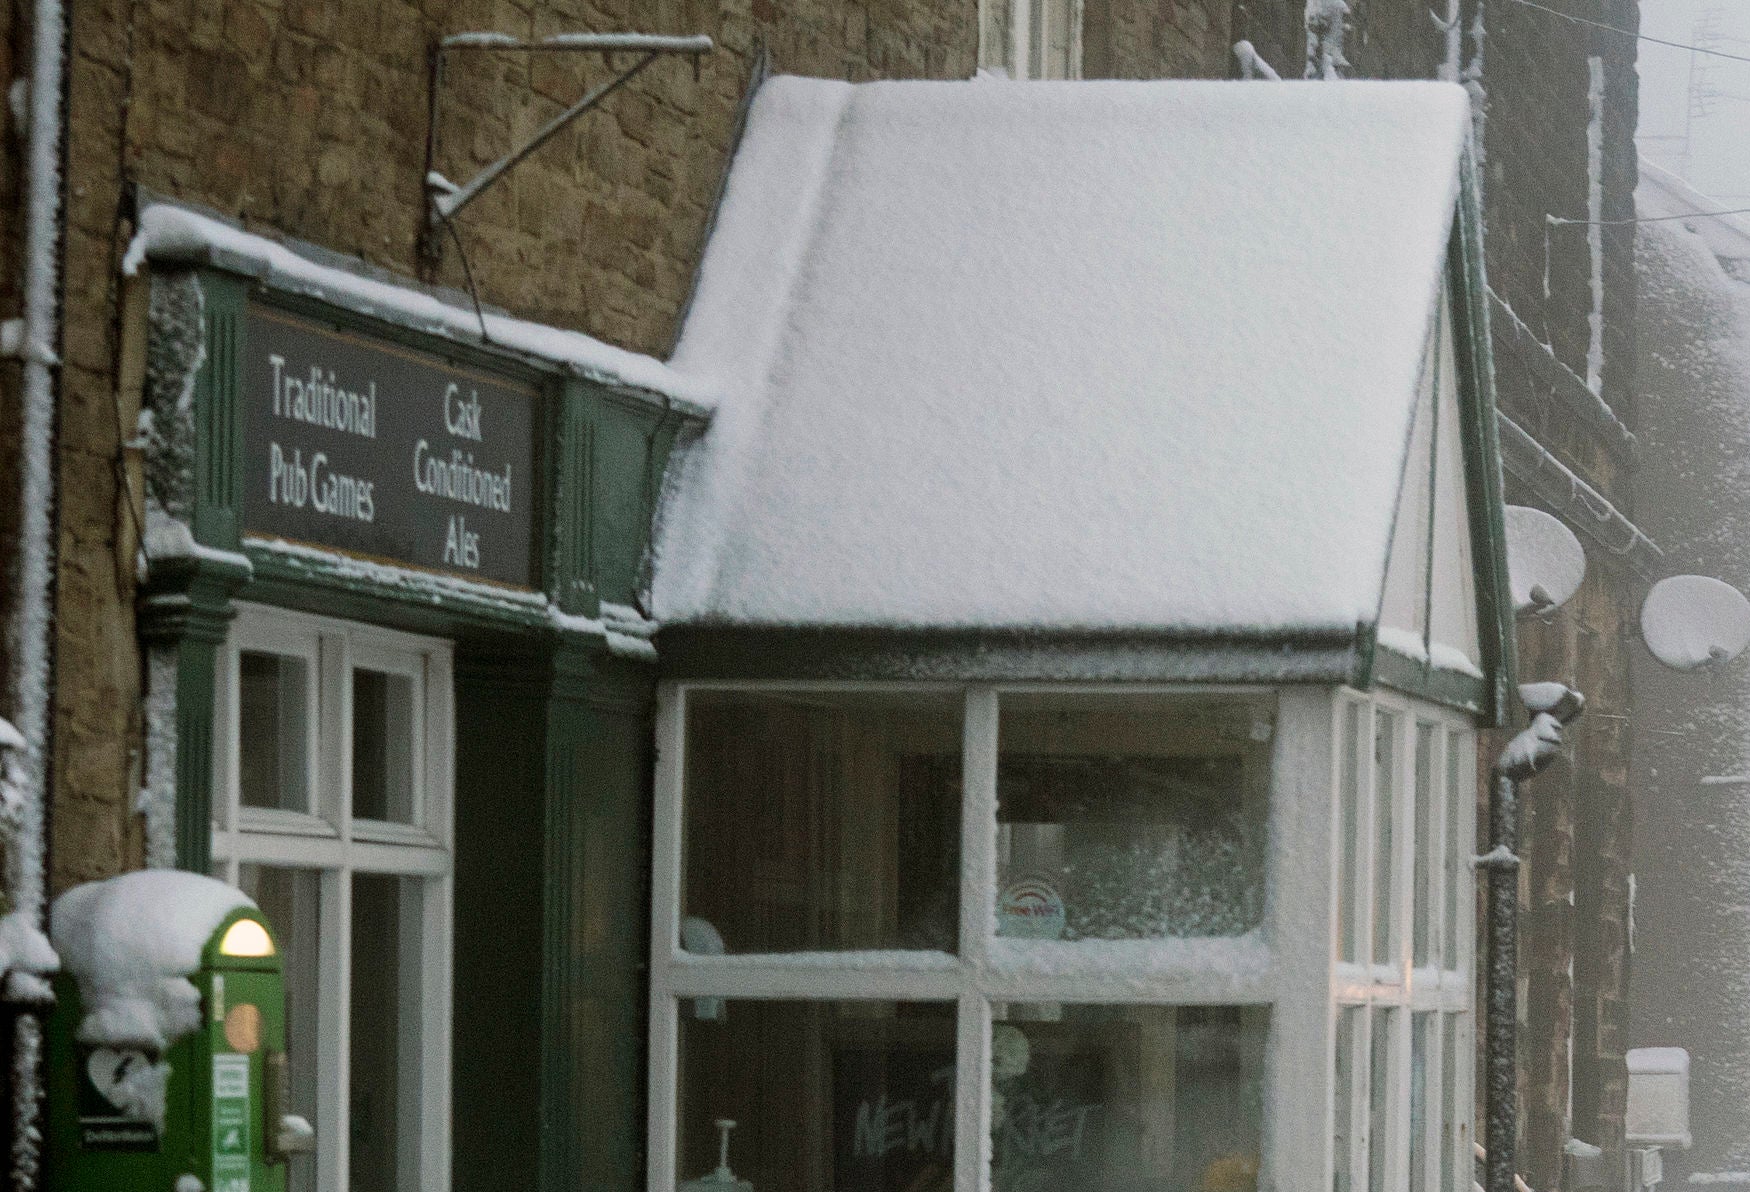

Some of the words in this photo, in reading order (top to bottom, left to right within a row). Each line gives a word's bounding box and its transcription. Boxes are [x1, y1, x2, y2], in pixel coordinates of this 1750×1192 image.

[269, 354, 376, 438] Traditional
[444, 382, 482, 441] Cask
[269, 441, 308, 508] Pub
[310, 452, 375, 523] Games
[415, 438, 511, 513] Conditioned
[444, 515, 480, 569] Ales
